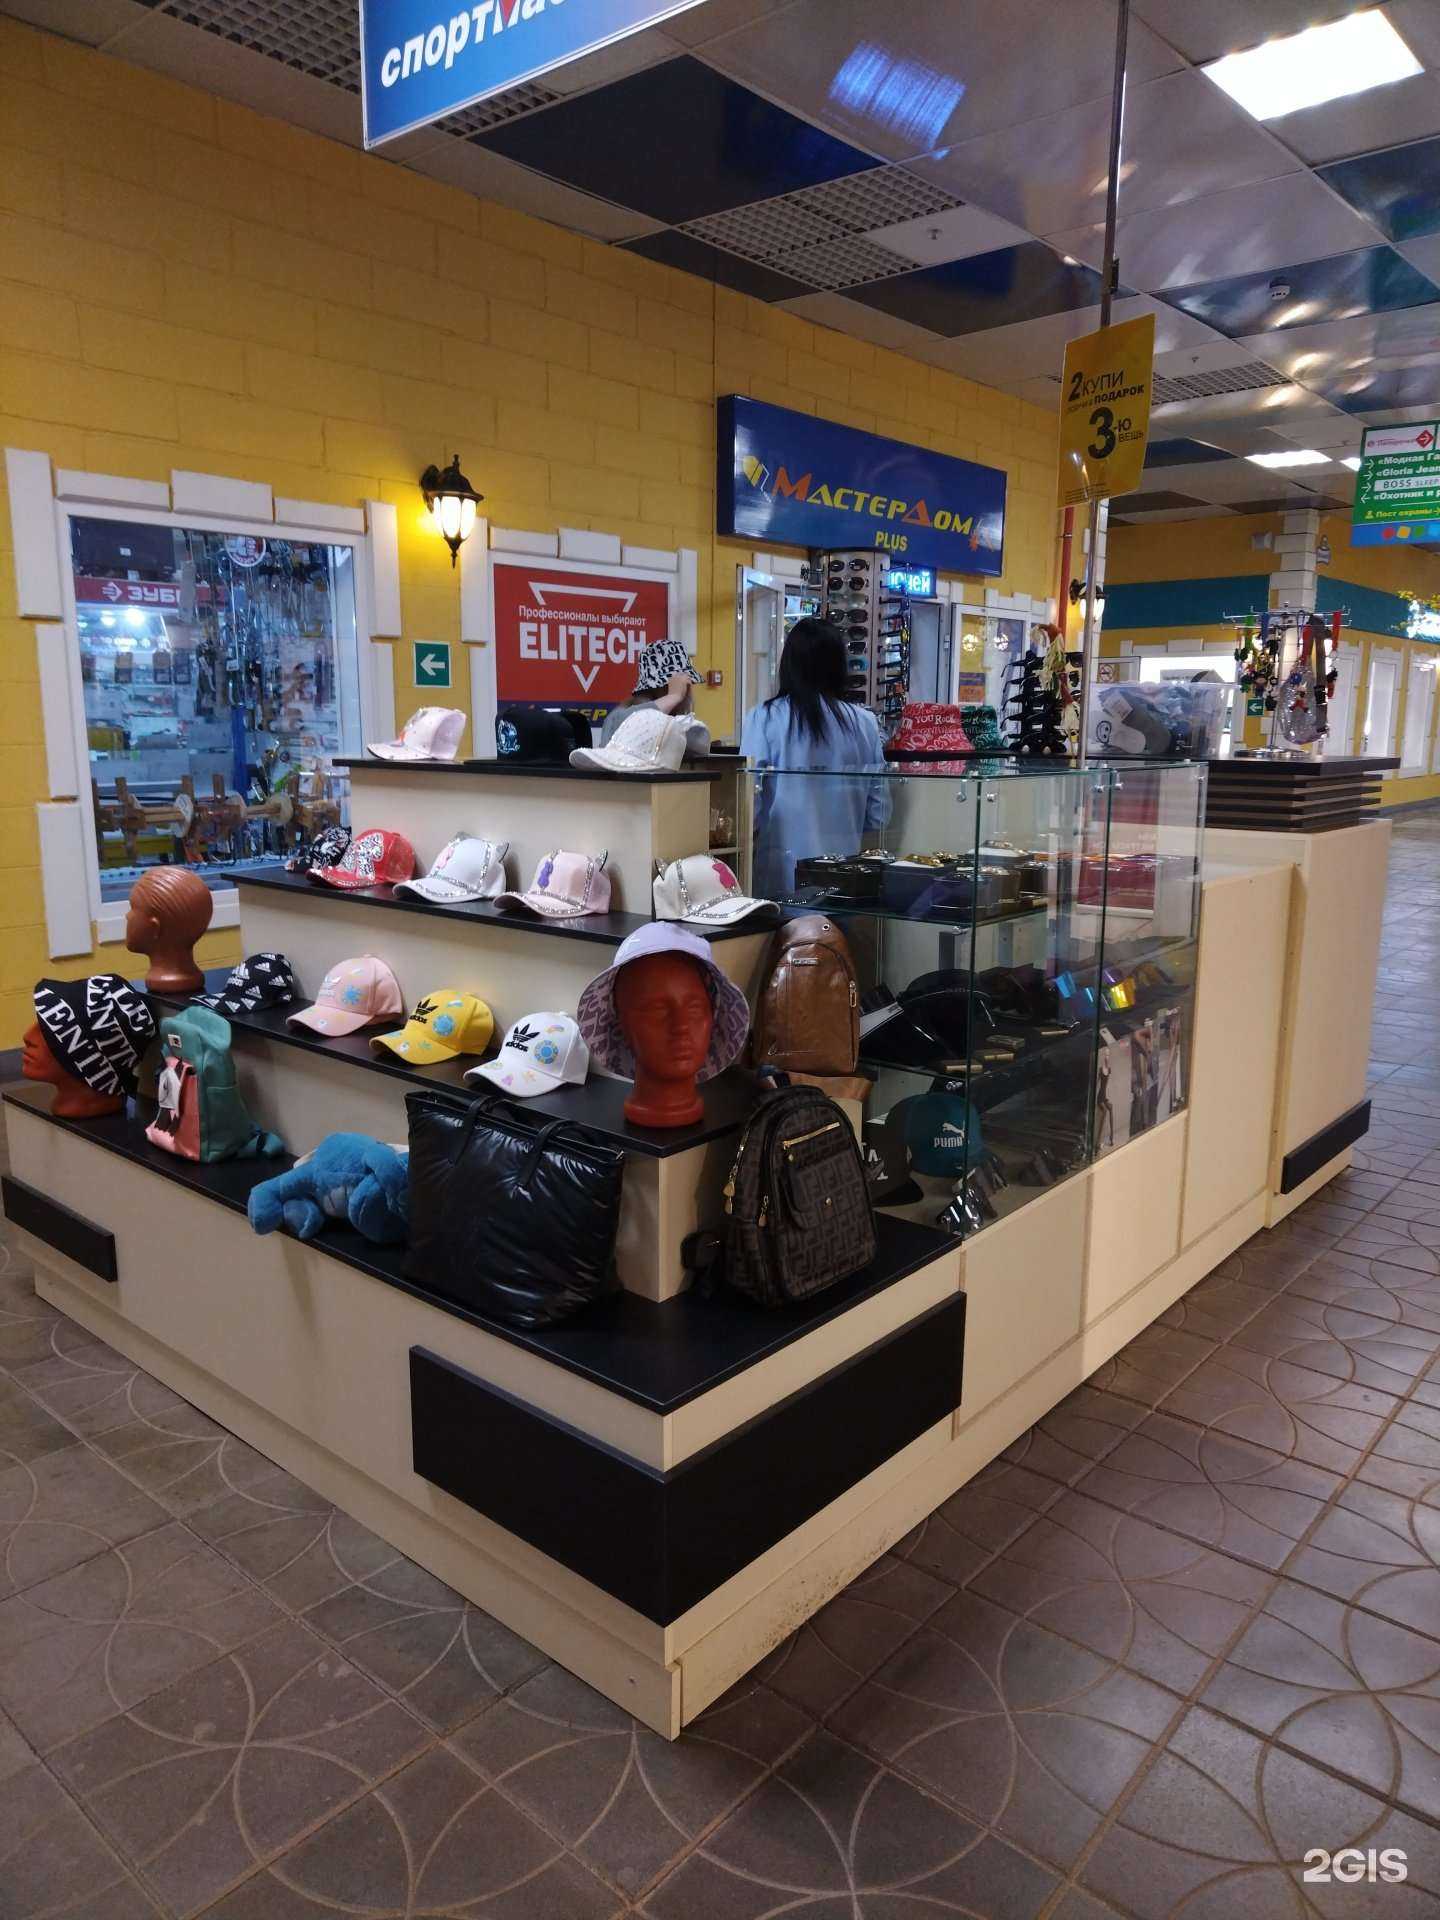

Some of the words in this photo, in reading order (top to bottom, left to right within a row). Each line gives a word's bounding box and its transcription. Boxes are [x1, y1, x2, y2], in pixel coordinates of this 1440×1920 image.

[380, 0, 565, 88] спортМа
[1094, 384, 1145, 405] ПОДАРОК
[1383, 479, 1412, 489] BOSS
[874, 530, 909, 552] PLUS
[127, 586, 180, 601] ЗУБ
[518, 605, 600, 623] Профессионалы
[601, 614, 646, 627] выбирают
[519, 622, 647, 665] ELITECH
[934, 1136, 963, 1148] PUMA
